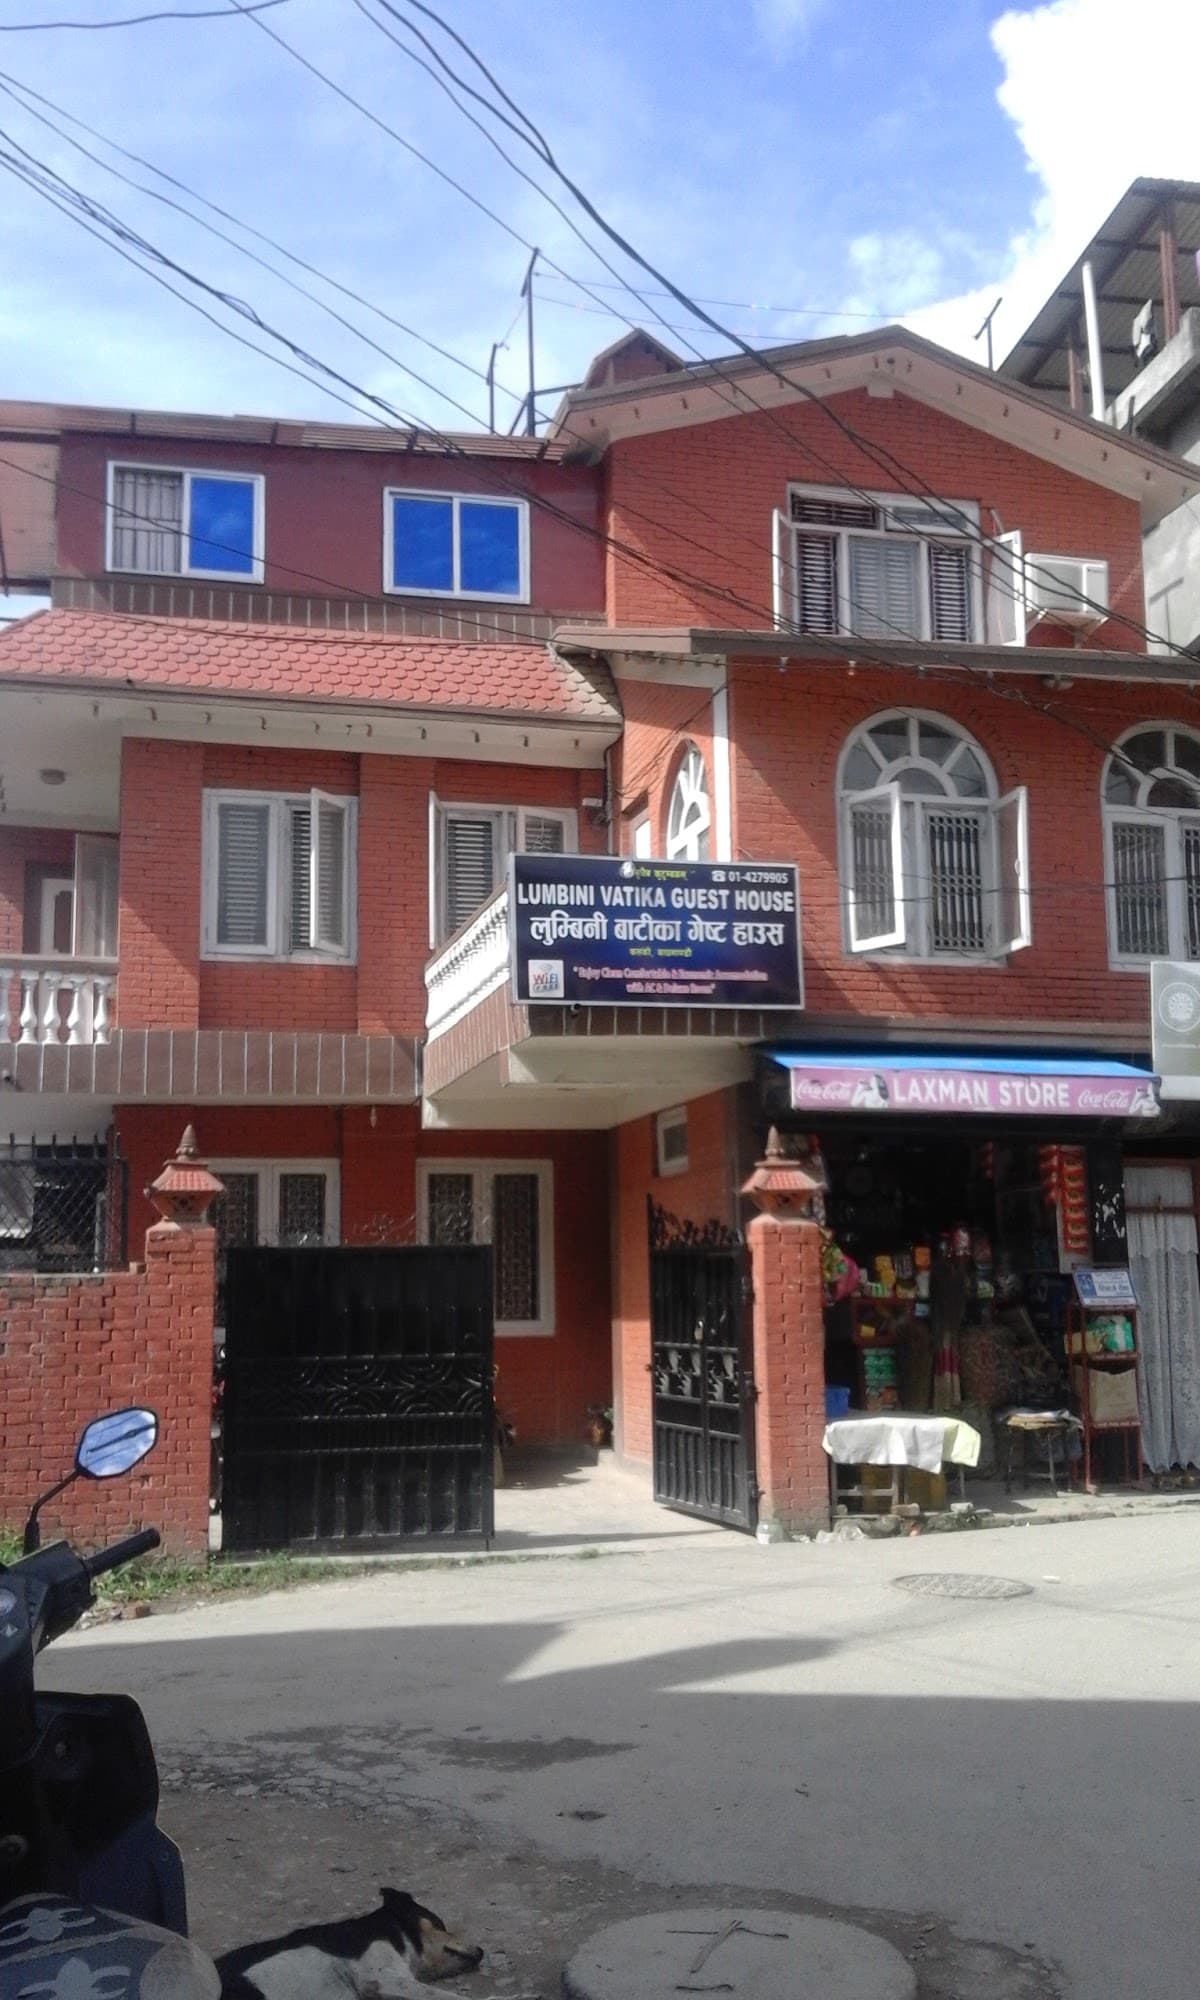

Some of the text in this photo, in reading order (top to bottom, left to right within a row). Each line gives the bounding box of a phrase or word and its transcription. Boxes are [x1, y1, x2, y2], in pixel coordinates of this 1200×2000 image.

[728, 871, 789, 884] 01-4279905
[517, 883, 795, 912] LUMBINI VATIKA GUEST HOUSE
[529, 909, 785, 946] लुम्बिनी बाटीका गेष्ट हाउस
[893, 1078, 989, 1109] LAXMAN
[999, 1081, 1069, 1109] STORE
